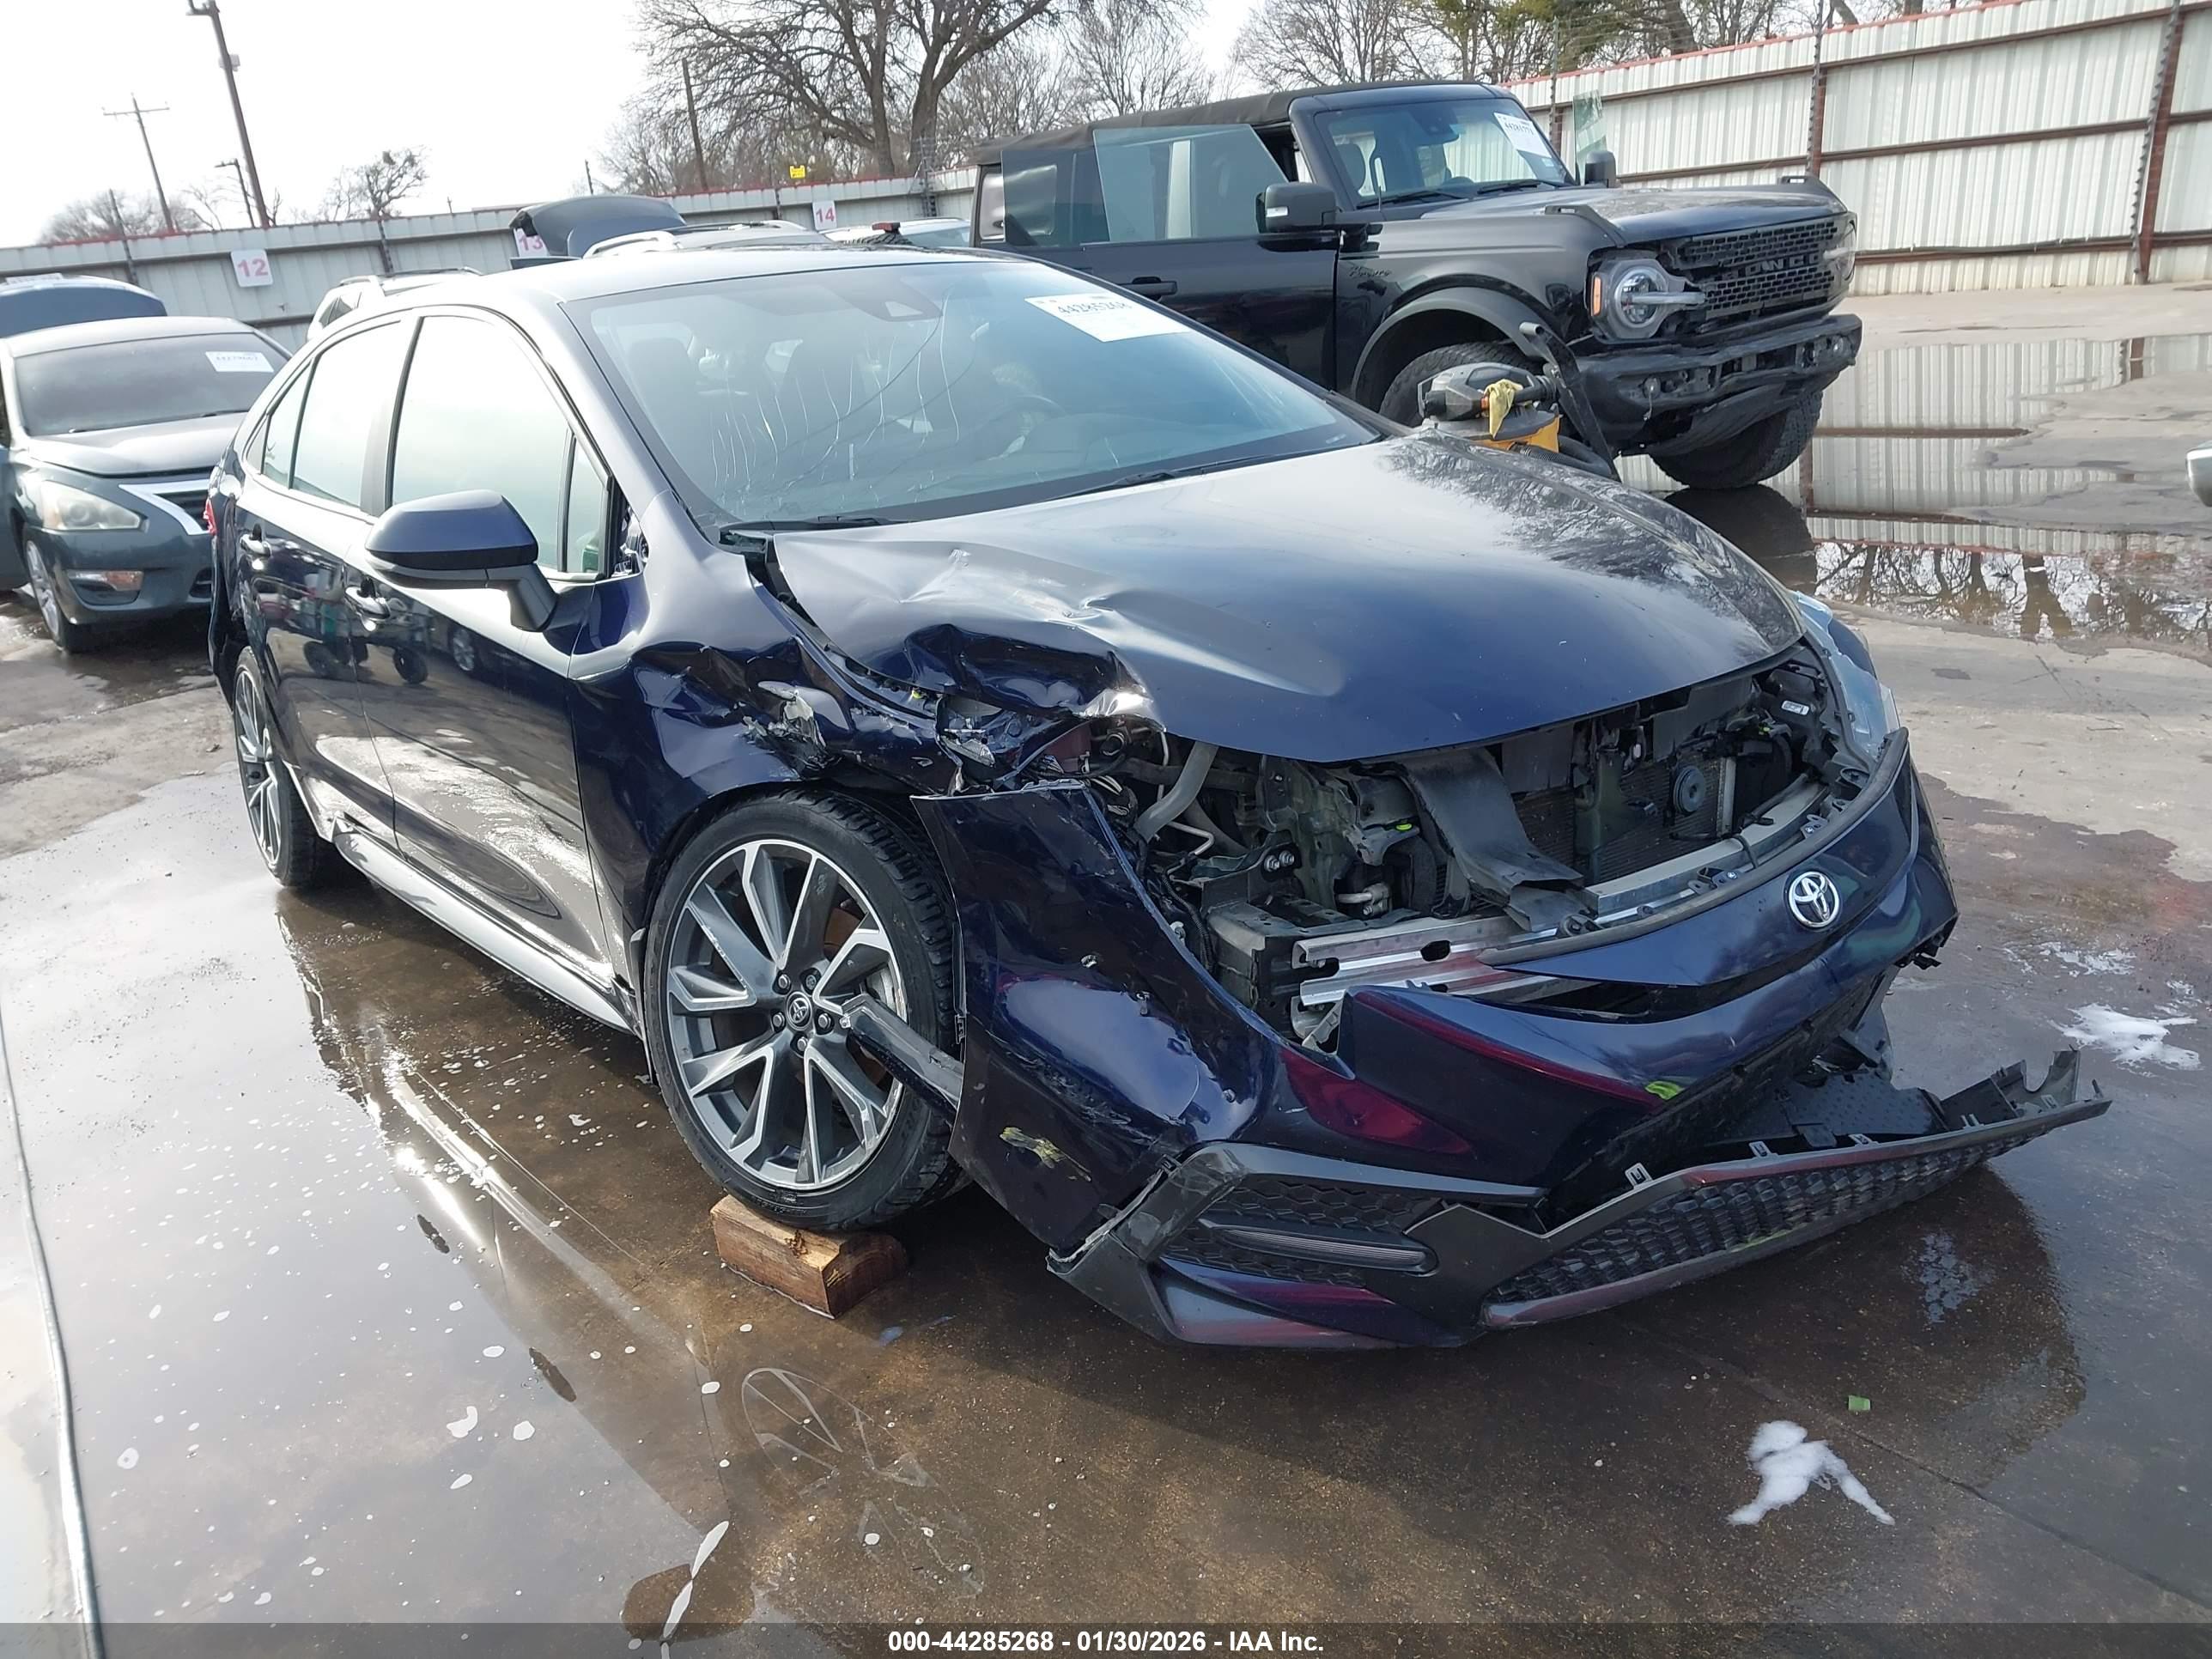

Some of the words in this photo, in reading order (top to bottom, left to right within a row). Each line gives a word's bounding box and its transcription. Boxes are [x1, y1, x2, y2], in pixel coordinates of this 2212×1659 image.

[816, 207, 835, 223] 14
[519, 234, 544, 251] 13
[238, 258, 269, 277] 12
